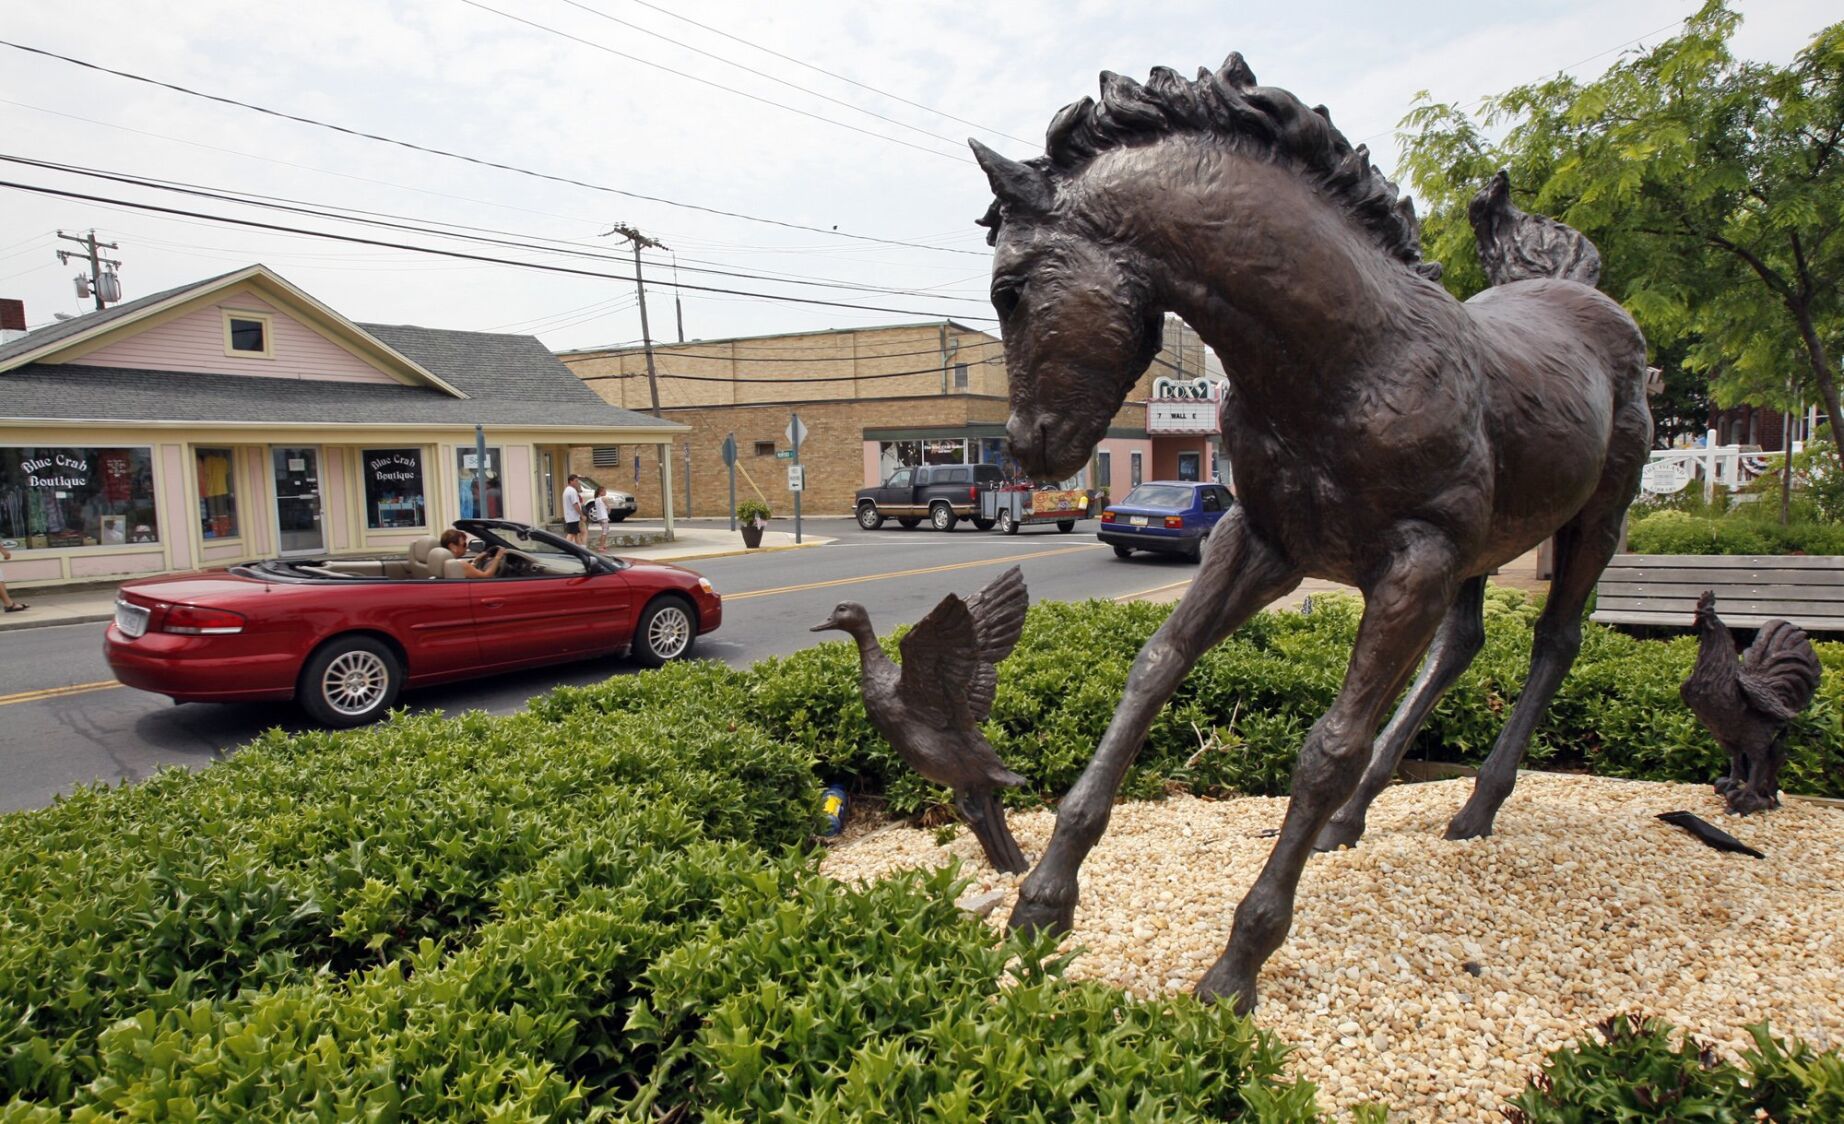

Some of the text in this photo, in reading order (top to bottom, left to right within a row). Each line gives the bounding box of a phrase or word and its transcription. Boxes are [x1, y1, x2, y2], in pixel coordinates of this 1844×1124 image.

[1162, 386, 1206, 399] ROXY
[21, 455, 87, 473] Blue Crab
[370, 454, 416, 470] Blue Crab
[30, 475, 86, 488] Boutique
[376, 471, 415, 481] Boutique
